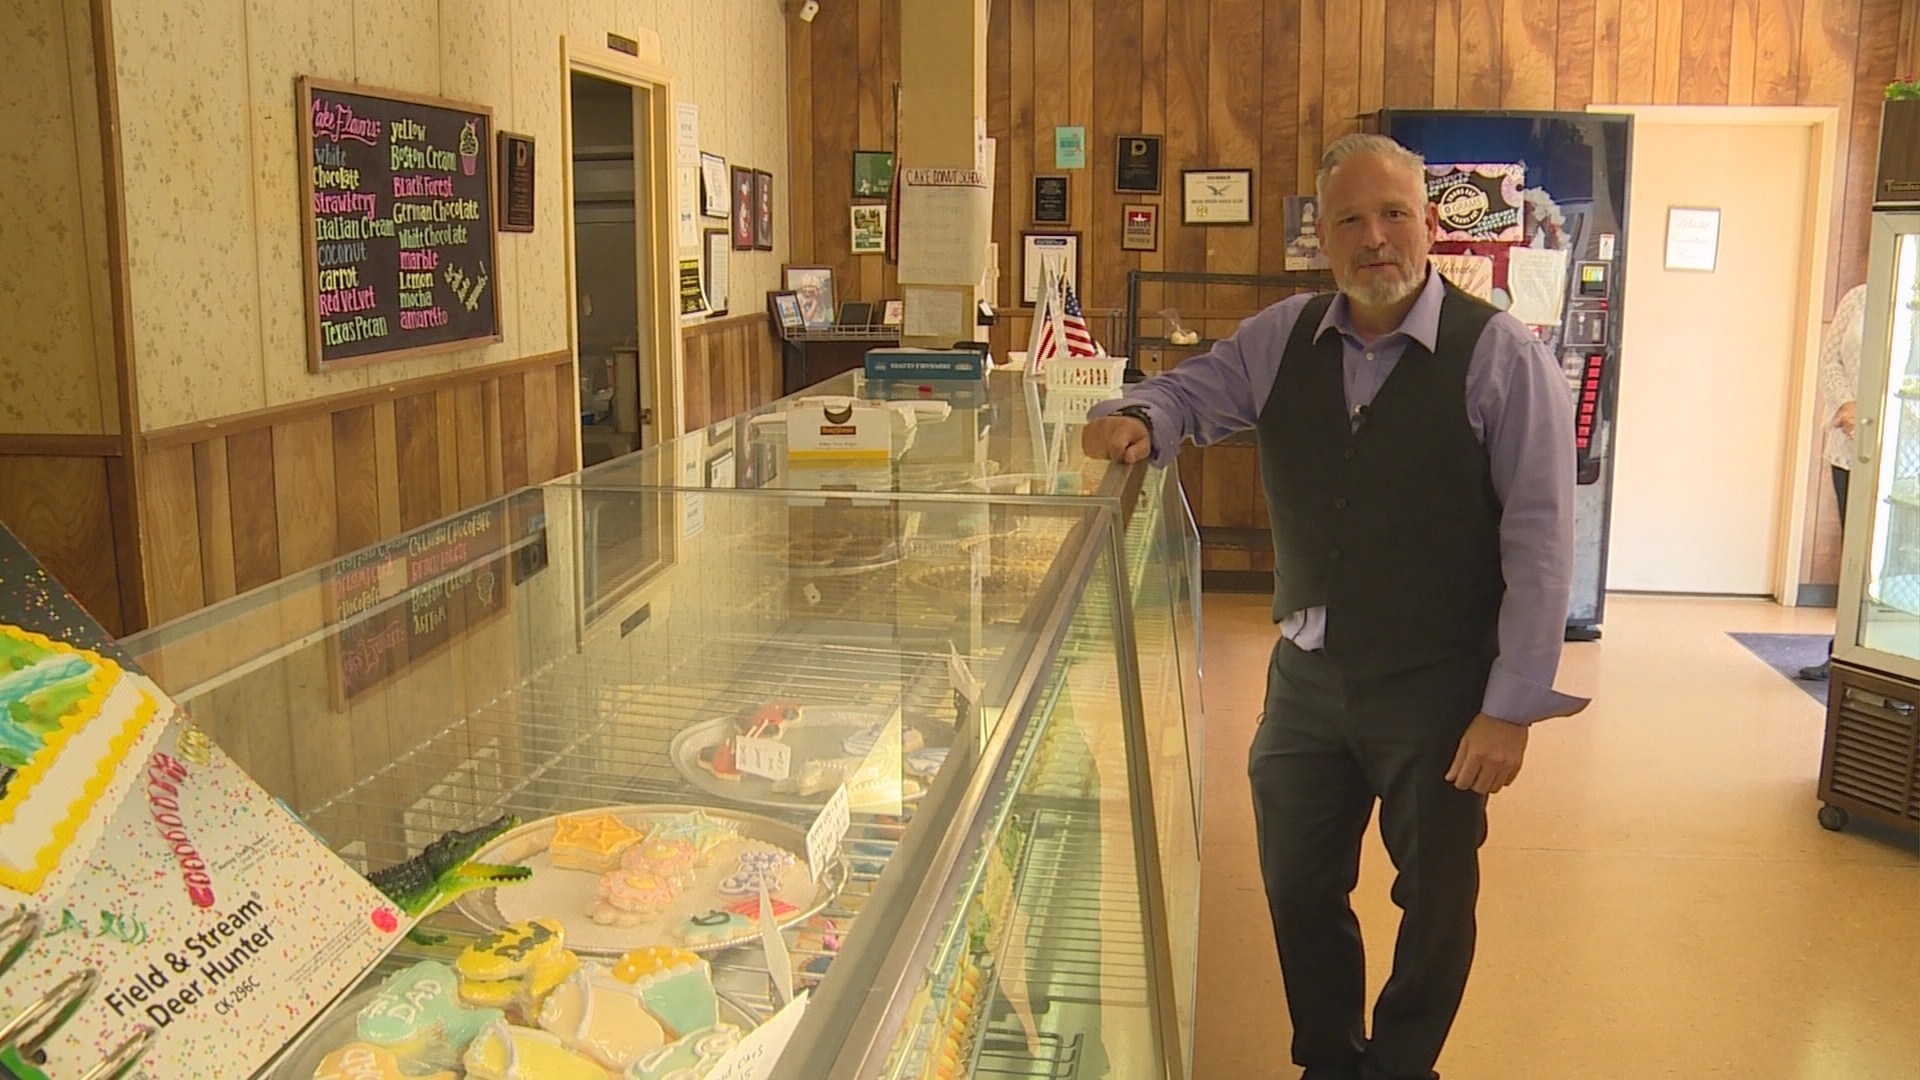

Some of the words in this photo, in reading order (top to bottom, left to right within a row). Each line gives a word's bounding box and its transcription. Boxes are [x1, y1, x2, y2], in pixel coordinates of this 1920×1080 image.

[315, 144, 346, 166] white
[390, 145, 425, 171] Boston
[426, 145, 457, 171] Cream
[313, 164, 360, 190] Chocolate
[393, 175, 423, 197] Black
[424, 176, 453, 197] Forest
[314, 191, 376, 220] Strawberry
[393, 203, 432, 224] German
[433, 198, 479, 221] Chocolate
[1452, 196, 1482, 212] GRAMS
[316, 217, 360, 240] Italian
[361, 216, 395, 239] Cream
[399, 227, 424, 248] White
[424, 224, 468, 246] Chocolate
[318, 241, 367, 266] coconut
[400, 248, 439, 270] marble
[320, 266, 359, 292] carrot
[399, 271, 434, 289] Lemon
[320, 289, 340, 316] Red
[340, 285, 376, 313] Velvet
[399, 289, 433, 308] mocha
[400, 306, 448, 329] amaretto
[322, 320, 356, 346] Texas
[355, 316, 388, 341] Pecan
[104, 963, 169, 1017] Field
[164, 952, 191, 973] &
[145, 979, 204, 1028] Deer
[199, 924, 275, 986] Hunter
[214, 975, 261, 1016] CK-296C
[387, 979, 442, 1024] DAD
